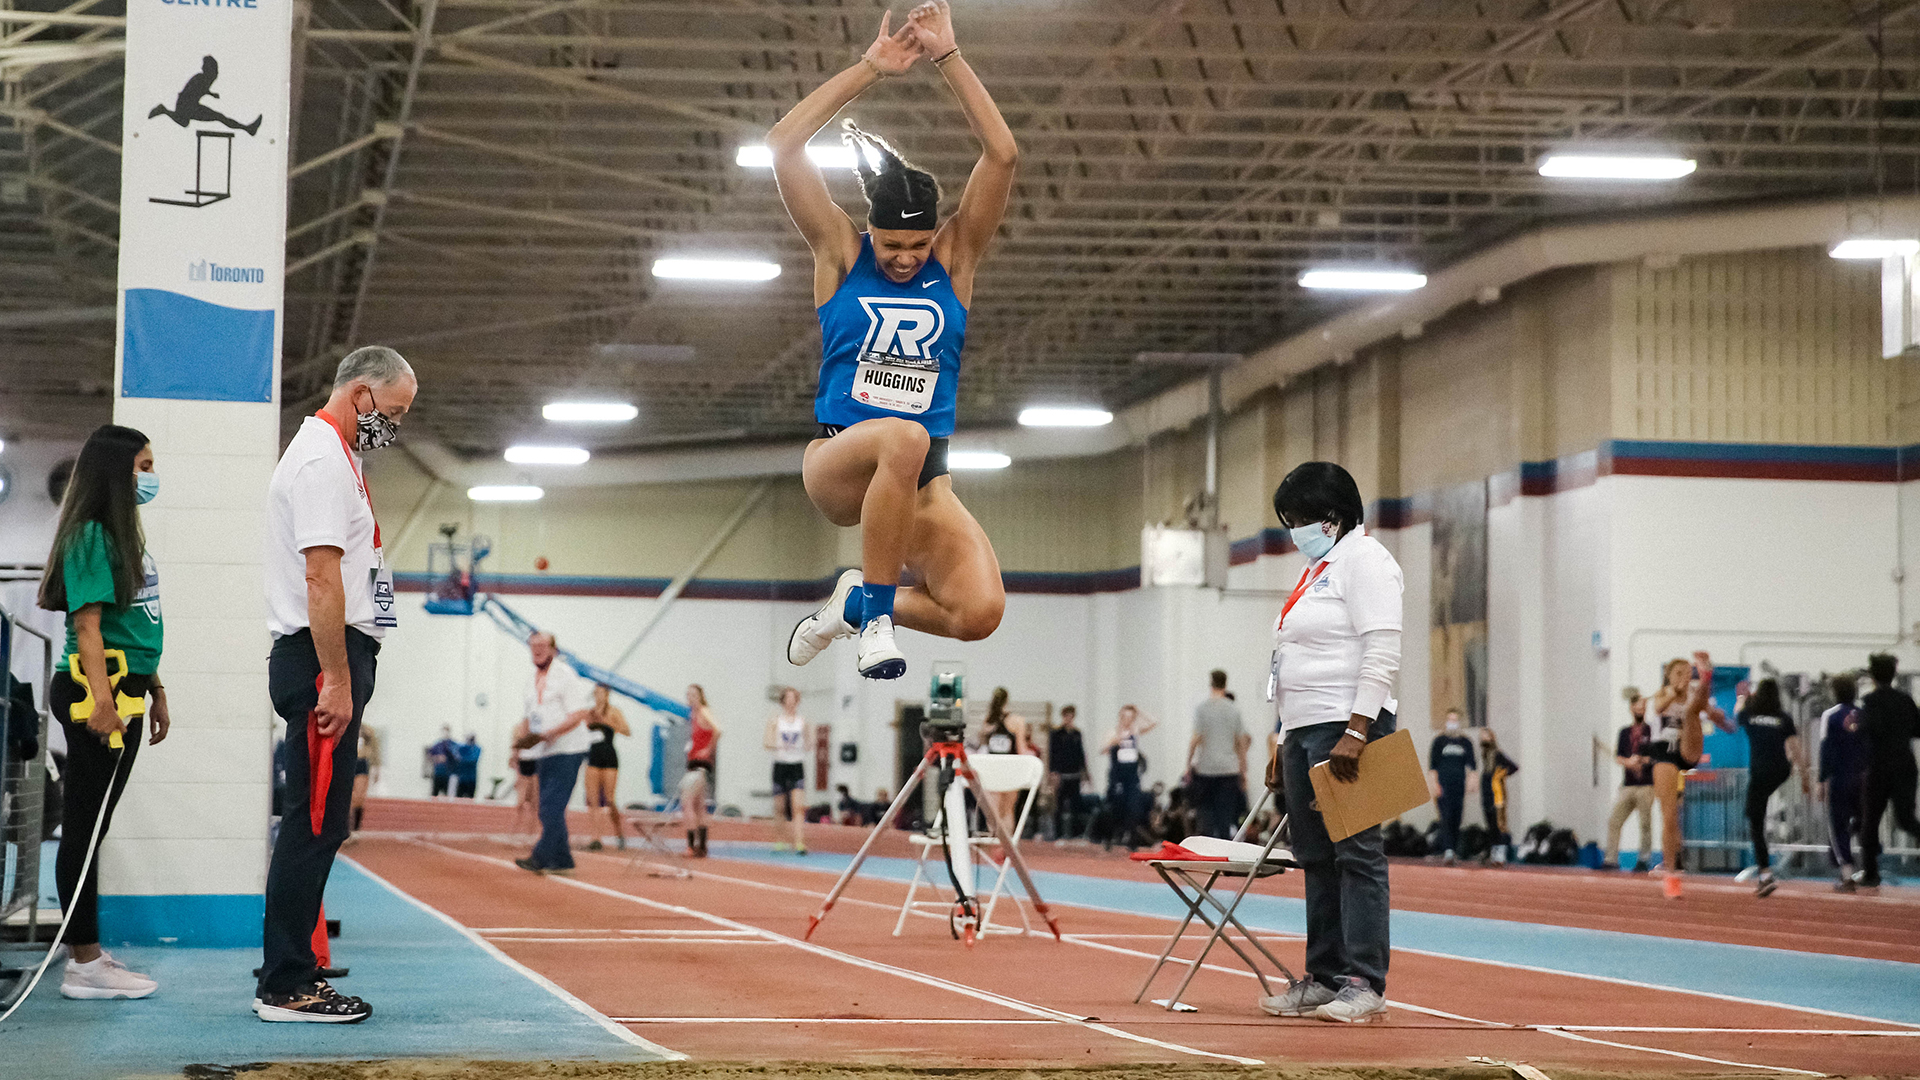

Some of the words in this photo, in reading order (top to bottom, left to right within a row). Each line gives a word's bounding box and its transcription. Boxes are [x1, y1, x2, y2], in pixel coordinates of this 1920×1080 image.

[210, 263, 264, 283] TORONTO
[857, 297, 945, 361] R
[864, 369, 926, 393] HUGGINS
